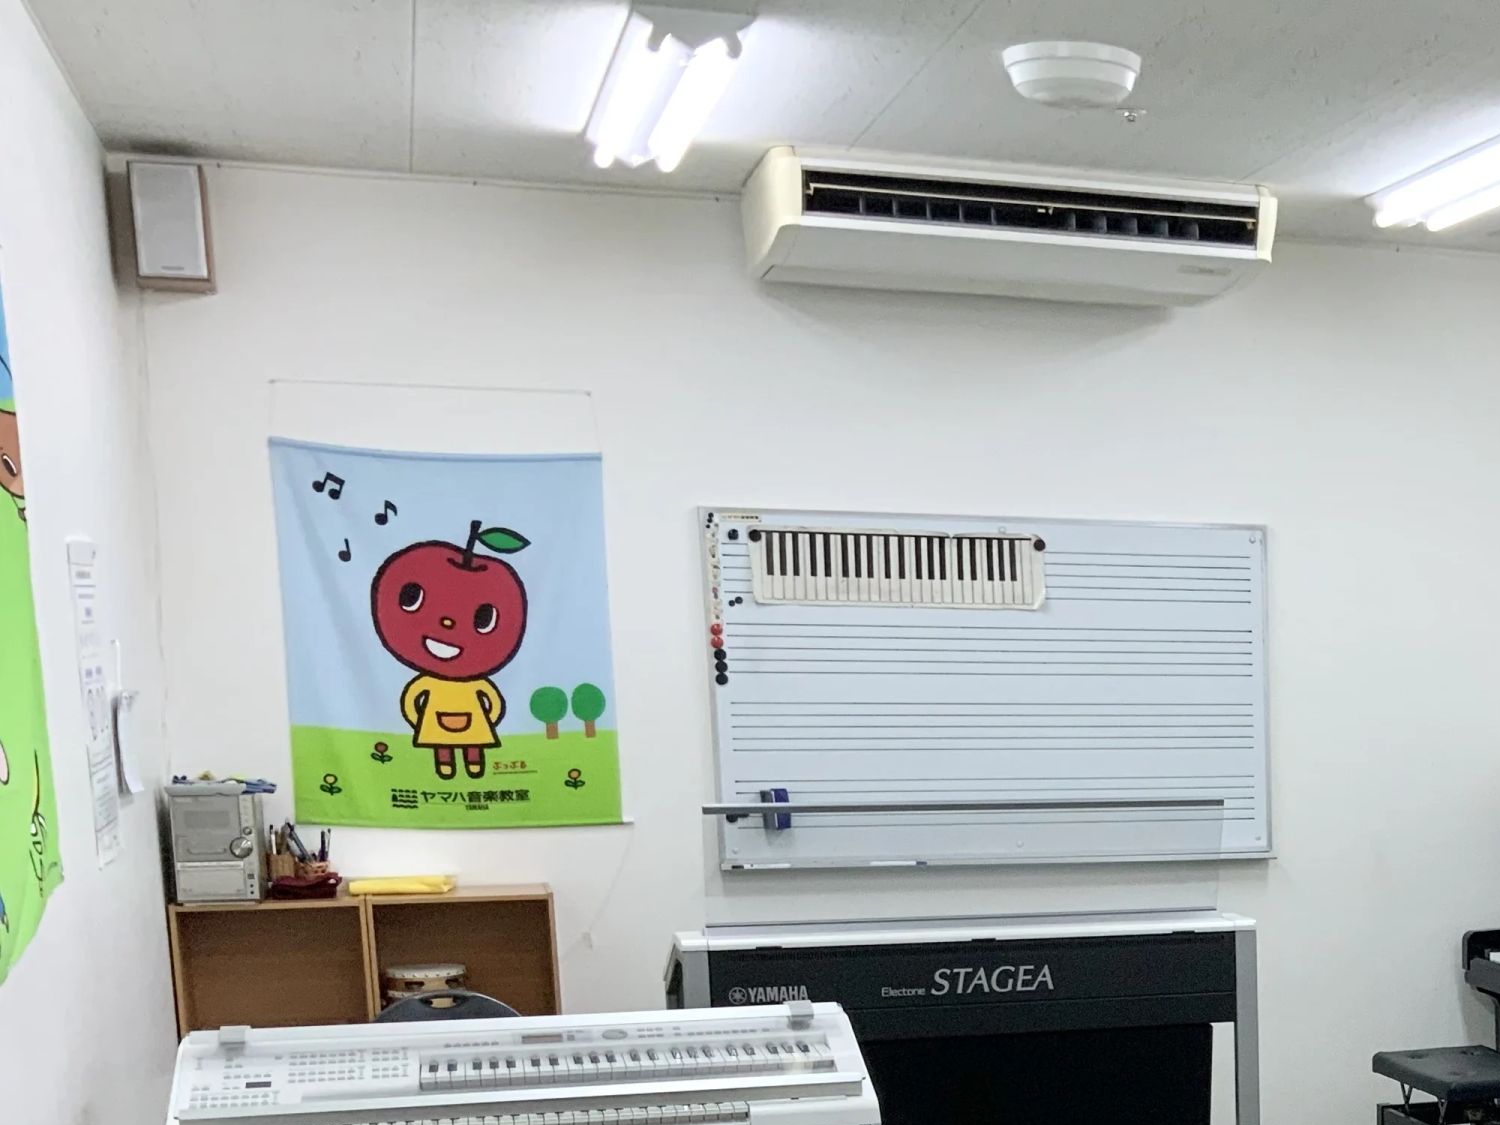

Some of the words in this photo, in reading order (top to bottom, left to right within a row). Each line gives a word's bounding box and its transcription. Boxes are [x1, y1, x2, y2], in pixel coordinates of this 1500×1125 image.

[420, 789, 530, 803] ヤマハ音楽教室
[881, 986, 926, 997] Electone
[930, 964, 1055, 996] STAGEA
[747, 985, 809, 1003] YAMAHA
